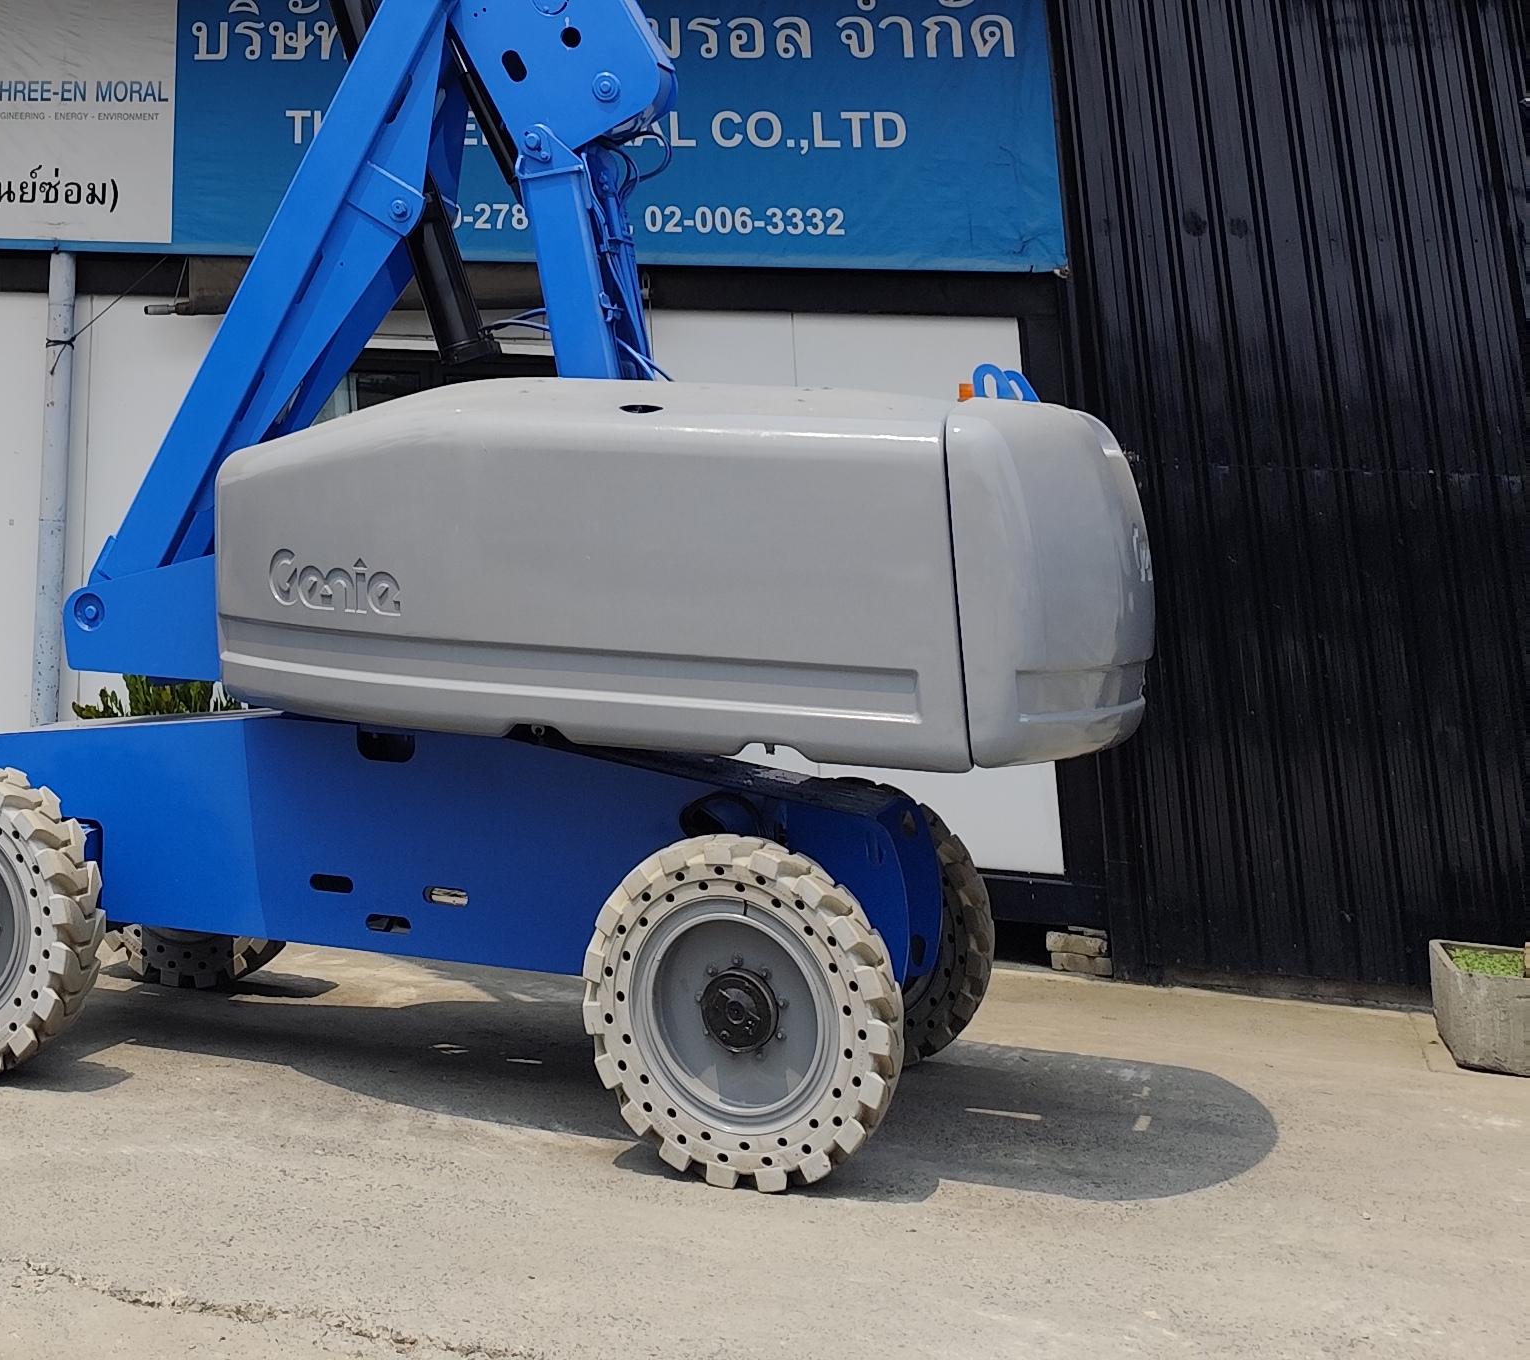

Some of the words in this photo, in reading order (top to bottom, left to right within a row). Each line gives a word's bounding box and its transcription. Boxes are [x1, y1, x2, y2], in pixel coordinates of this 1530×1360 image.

[95, 81, 169, 103] MORAL
[54, 111, 89, 121] ENERGY
[97, 112, 160, 121] ENVIRONMENT
[711, 110, 907, 155] CO.,LTD
[644, 205, 846, 236] 02-006-3332
[268, 548, 402, 617] Genie
